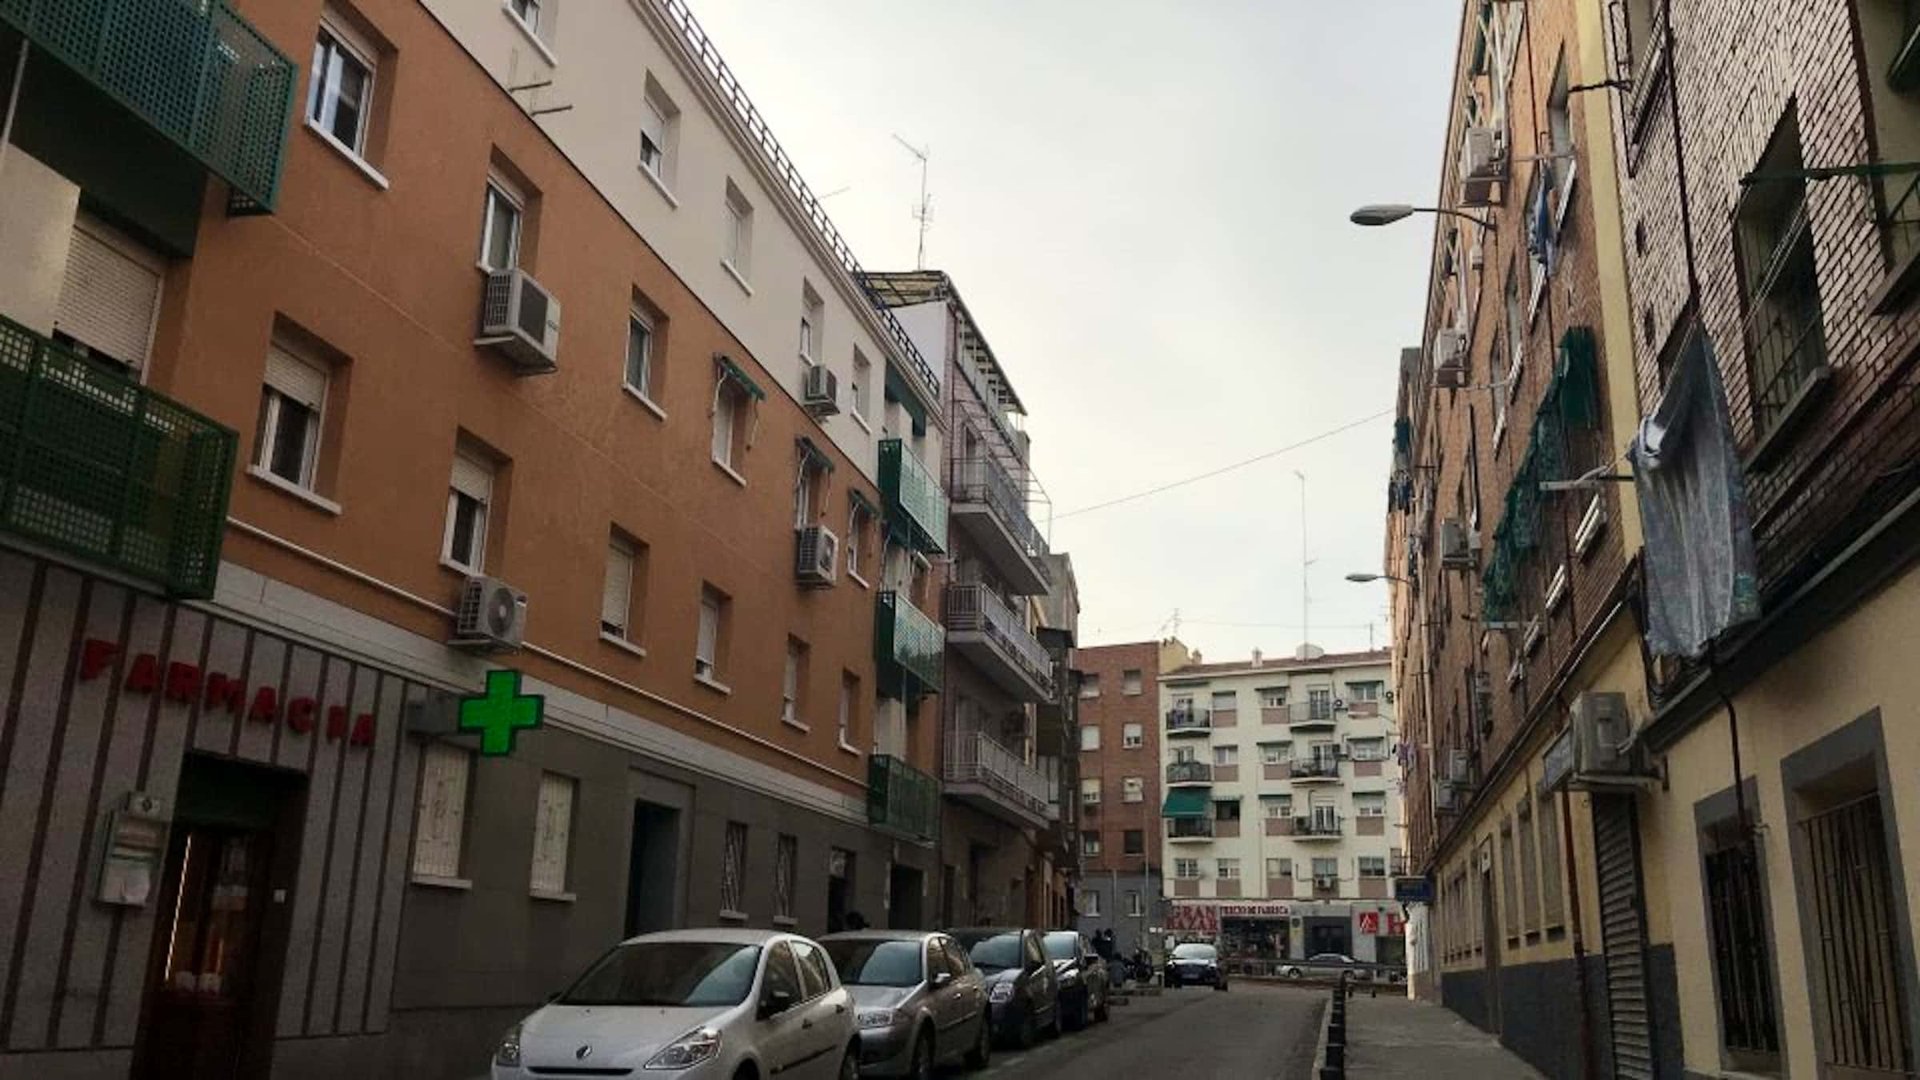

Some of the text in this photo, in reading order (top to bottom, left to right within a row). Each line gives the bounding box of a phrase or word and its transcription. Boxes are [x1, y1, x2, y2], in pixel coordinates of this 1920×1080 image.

[78, 638, 375, 746] FARMACIA
[1172, 905, 1217, 919] GRAN
[1166, 918, 1218, 931] BAZAR
